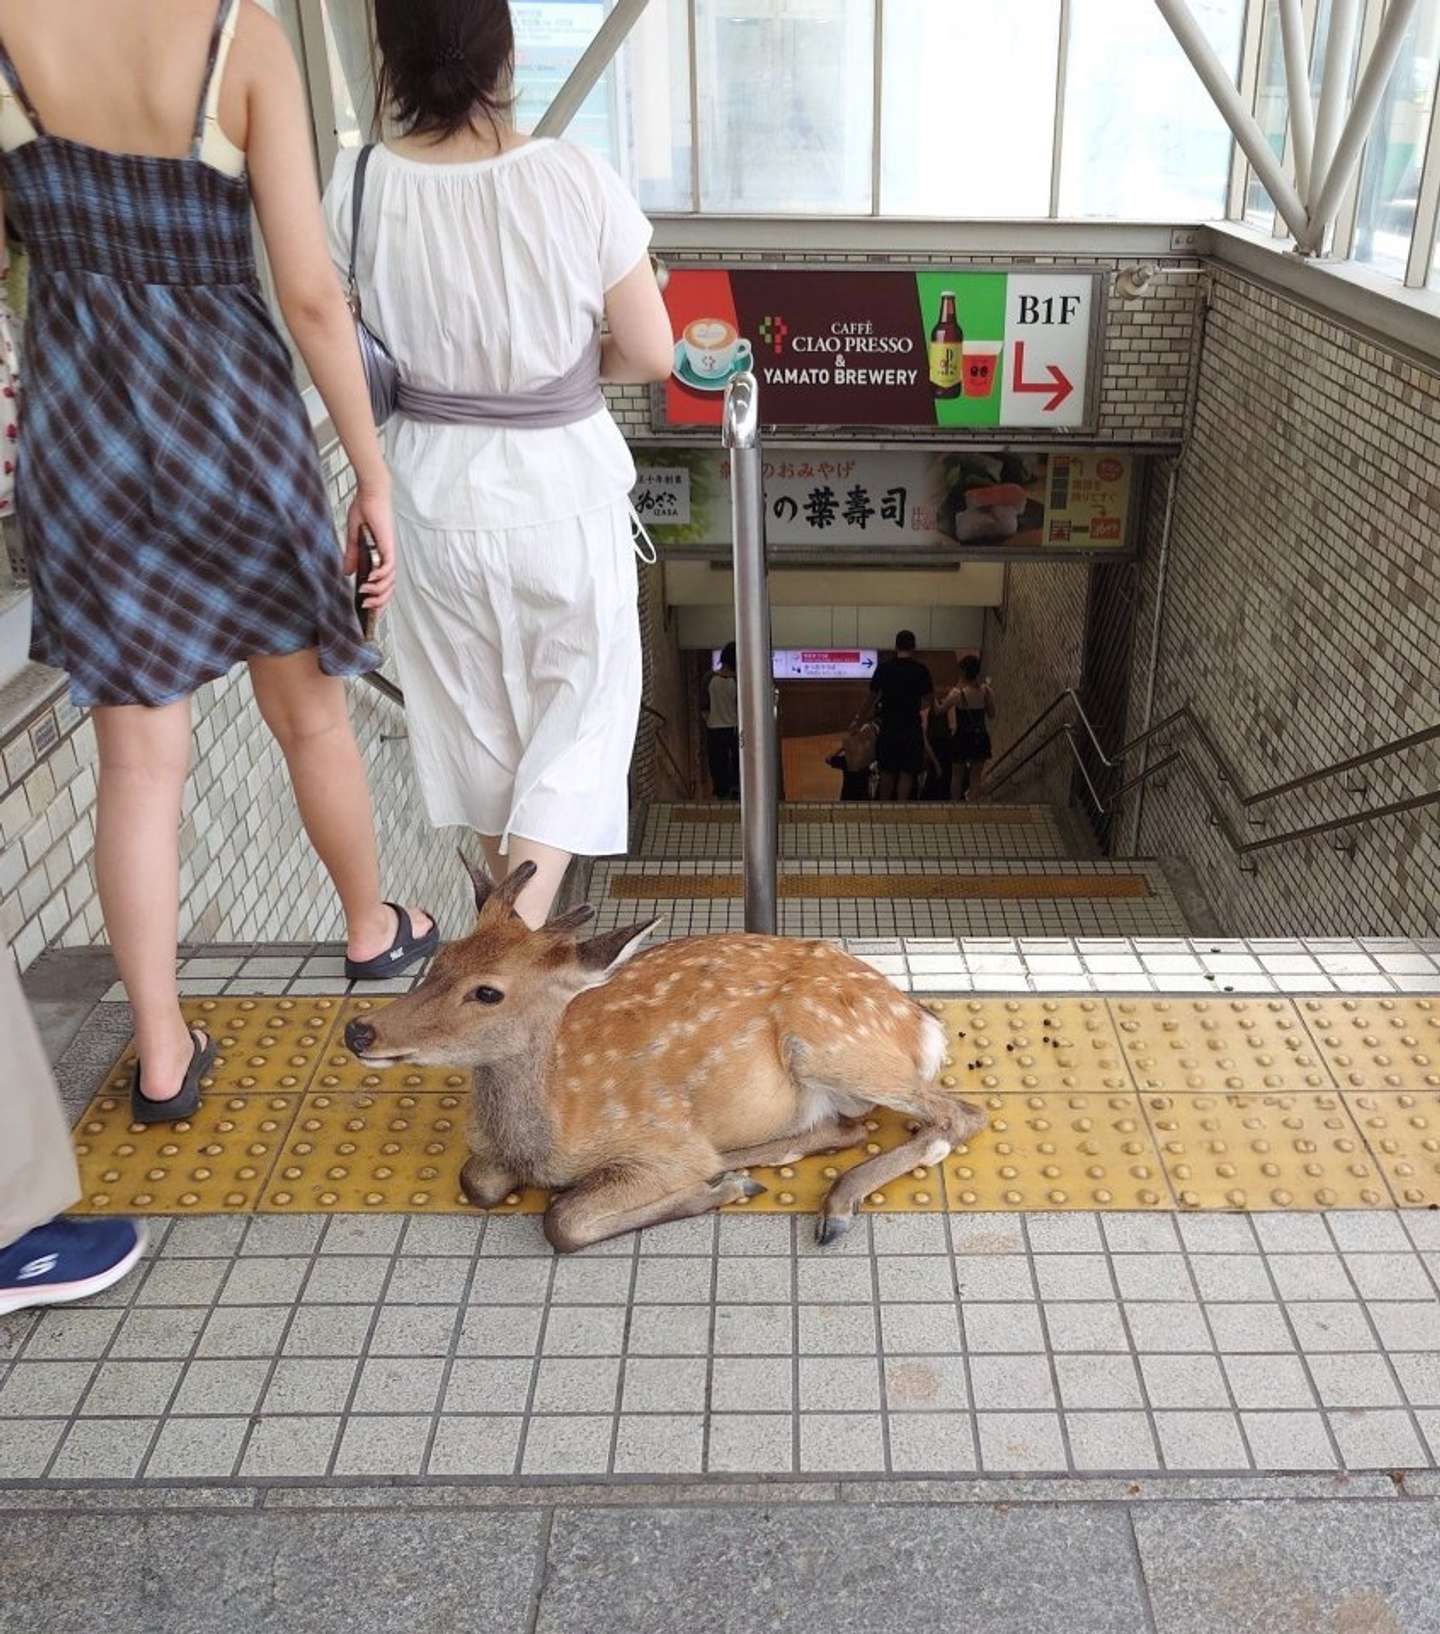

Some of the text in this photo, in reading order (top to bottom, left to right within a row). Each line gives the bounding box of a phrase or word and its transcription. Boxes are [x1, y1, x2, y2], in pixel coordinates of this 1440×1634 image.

[1016, 295, 1081, 325] B1F
[792, 336, 914, 354] CIAO PRESSO
[834, 354, 846, 368] &
[764, 368, 918, 386] YAMATO BREWERY
[763, 484, 908, 529] の葉壽司
